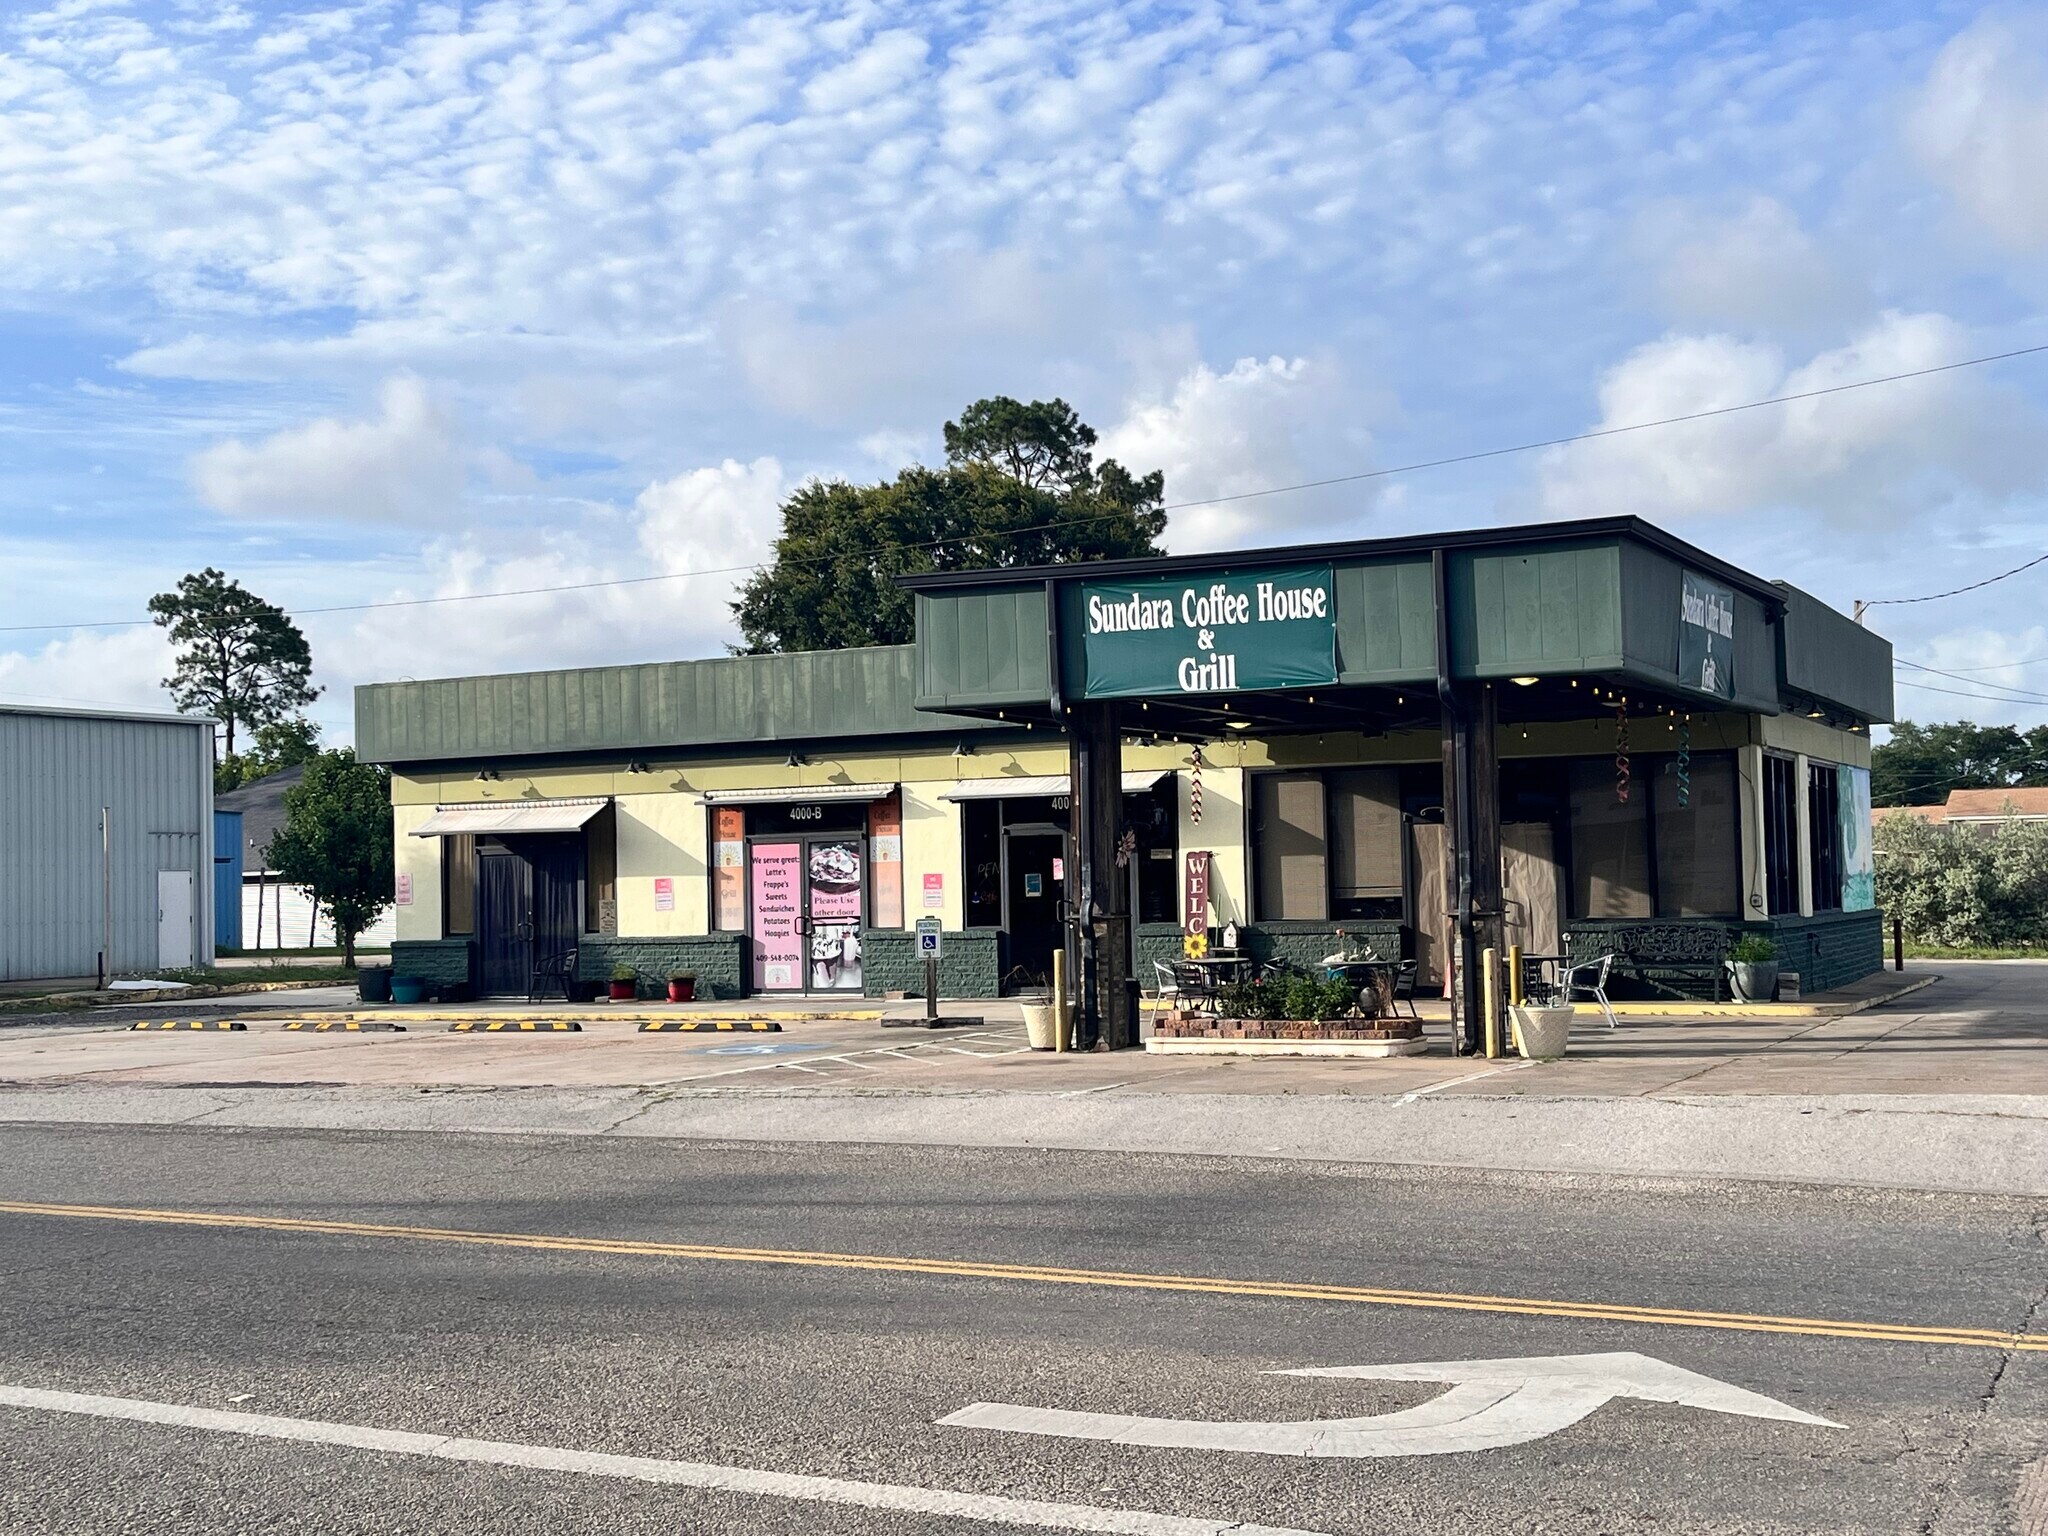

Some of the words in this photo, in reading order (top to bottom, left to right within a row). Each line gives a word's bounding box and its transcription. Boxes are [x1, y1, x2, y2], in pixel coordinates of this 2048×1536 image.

[1088, 592, 1174, 634] Sundara
[1181, 584, 1249, 628] Coffee
[1256, 582, 1327, 622] House
[1197, 628, 1215, 650] &
[1178, 652, 1237, 692] Grill
[1051, 796, 1070, 810] 400
[790, 806, 822, 820] 4000-B
[763, 881, 789, 889] Frappe's
[840, 896, 855, 904] Use
[1188, 858, 1207, 934] WELC
[758, 905, 795, 913] Sandwiches
[763, 917, 791, 925] Potatoes
[764, 930, 790, 939] Hoagies
[755, 954, 800, 962] 409-548-0074
